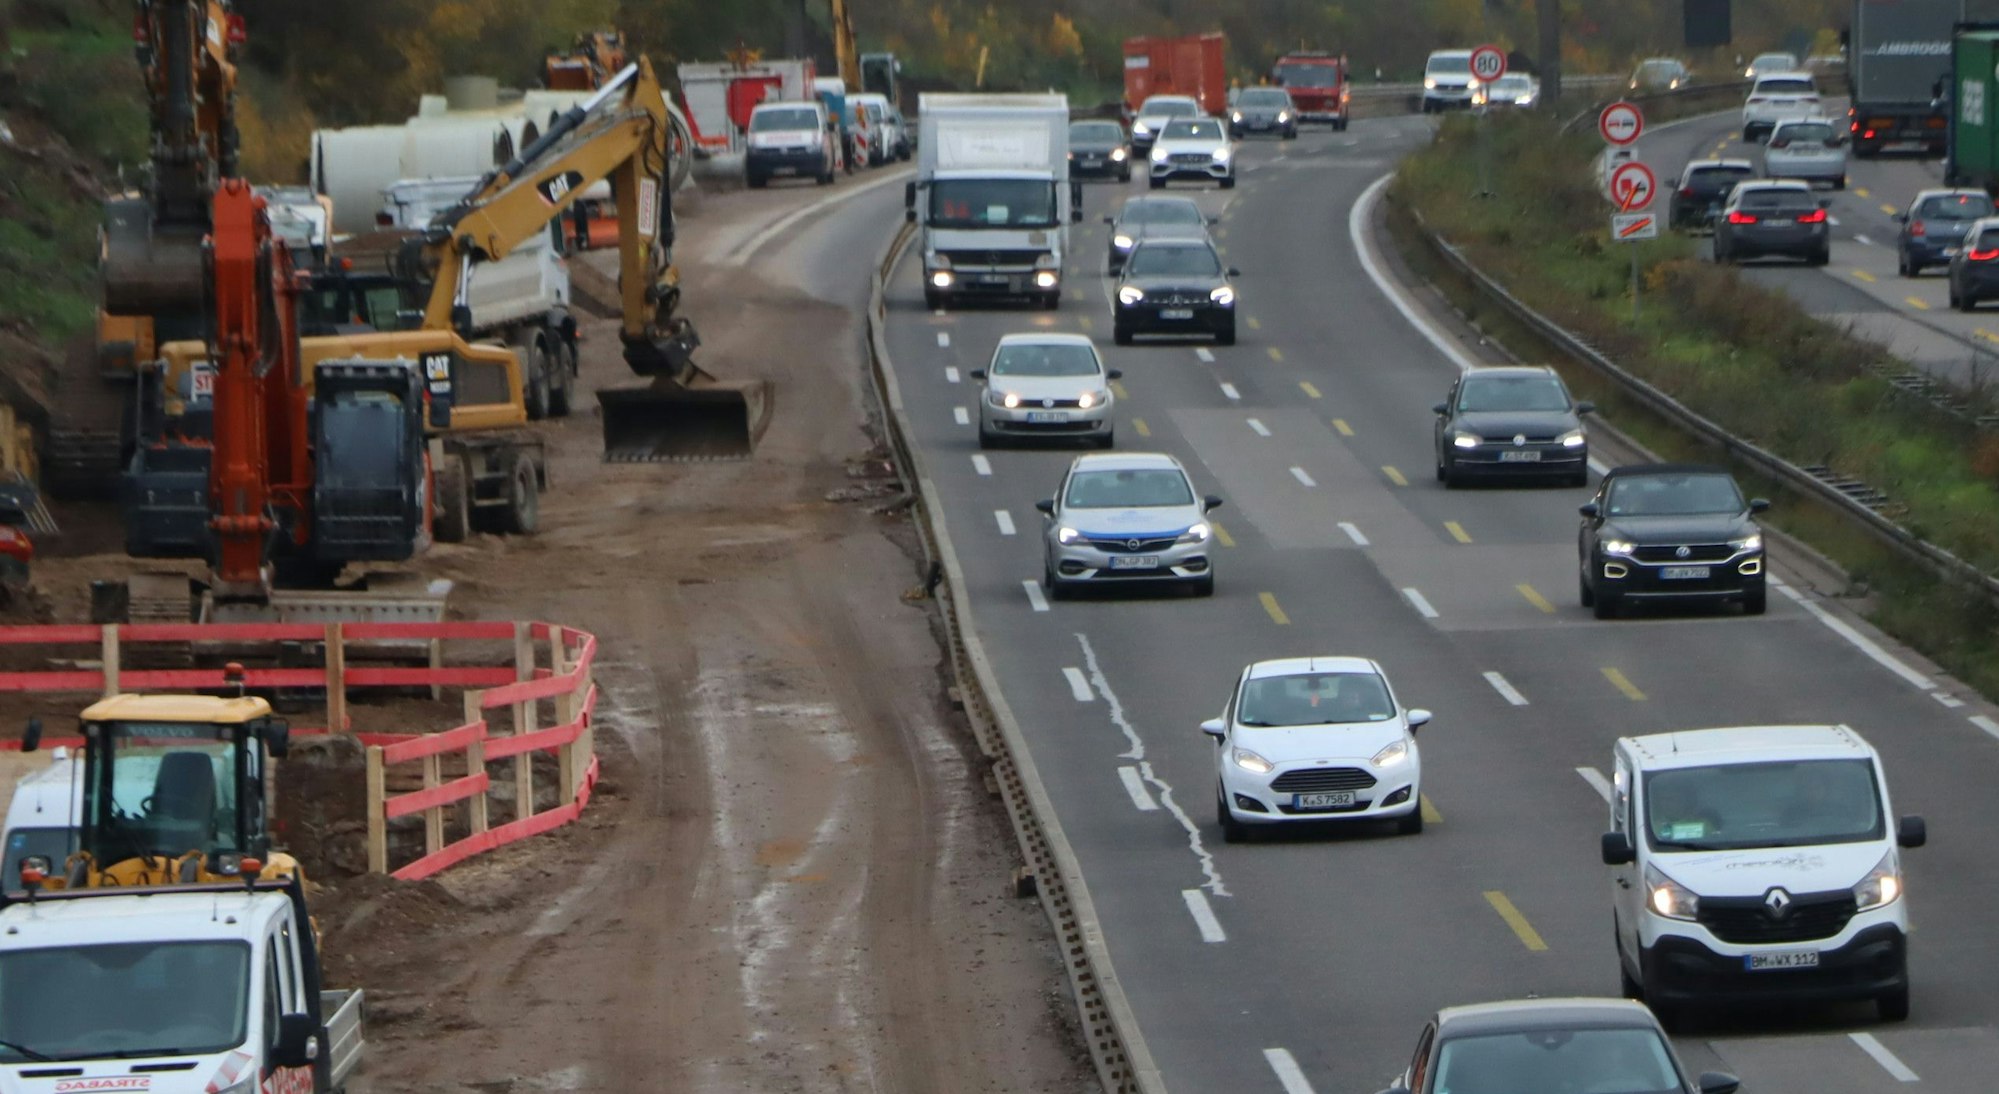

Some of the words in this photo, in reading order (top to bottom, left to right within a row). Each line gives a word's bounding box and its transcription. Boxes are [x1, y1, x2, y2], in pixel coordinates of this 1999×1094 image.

[1477, 56, 1499, 73] 80
[549, 173, 570, 203] CAT
[426, 355, 450, 380] CAT
[128, 726, 195, 737] VOLVO
[1752, 955, 1768, 967] BM
[1795, 952, 1817, 965] 112
